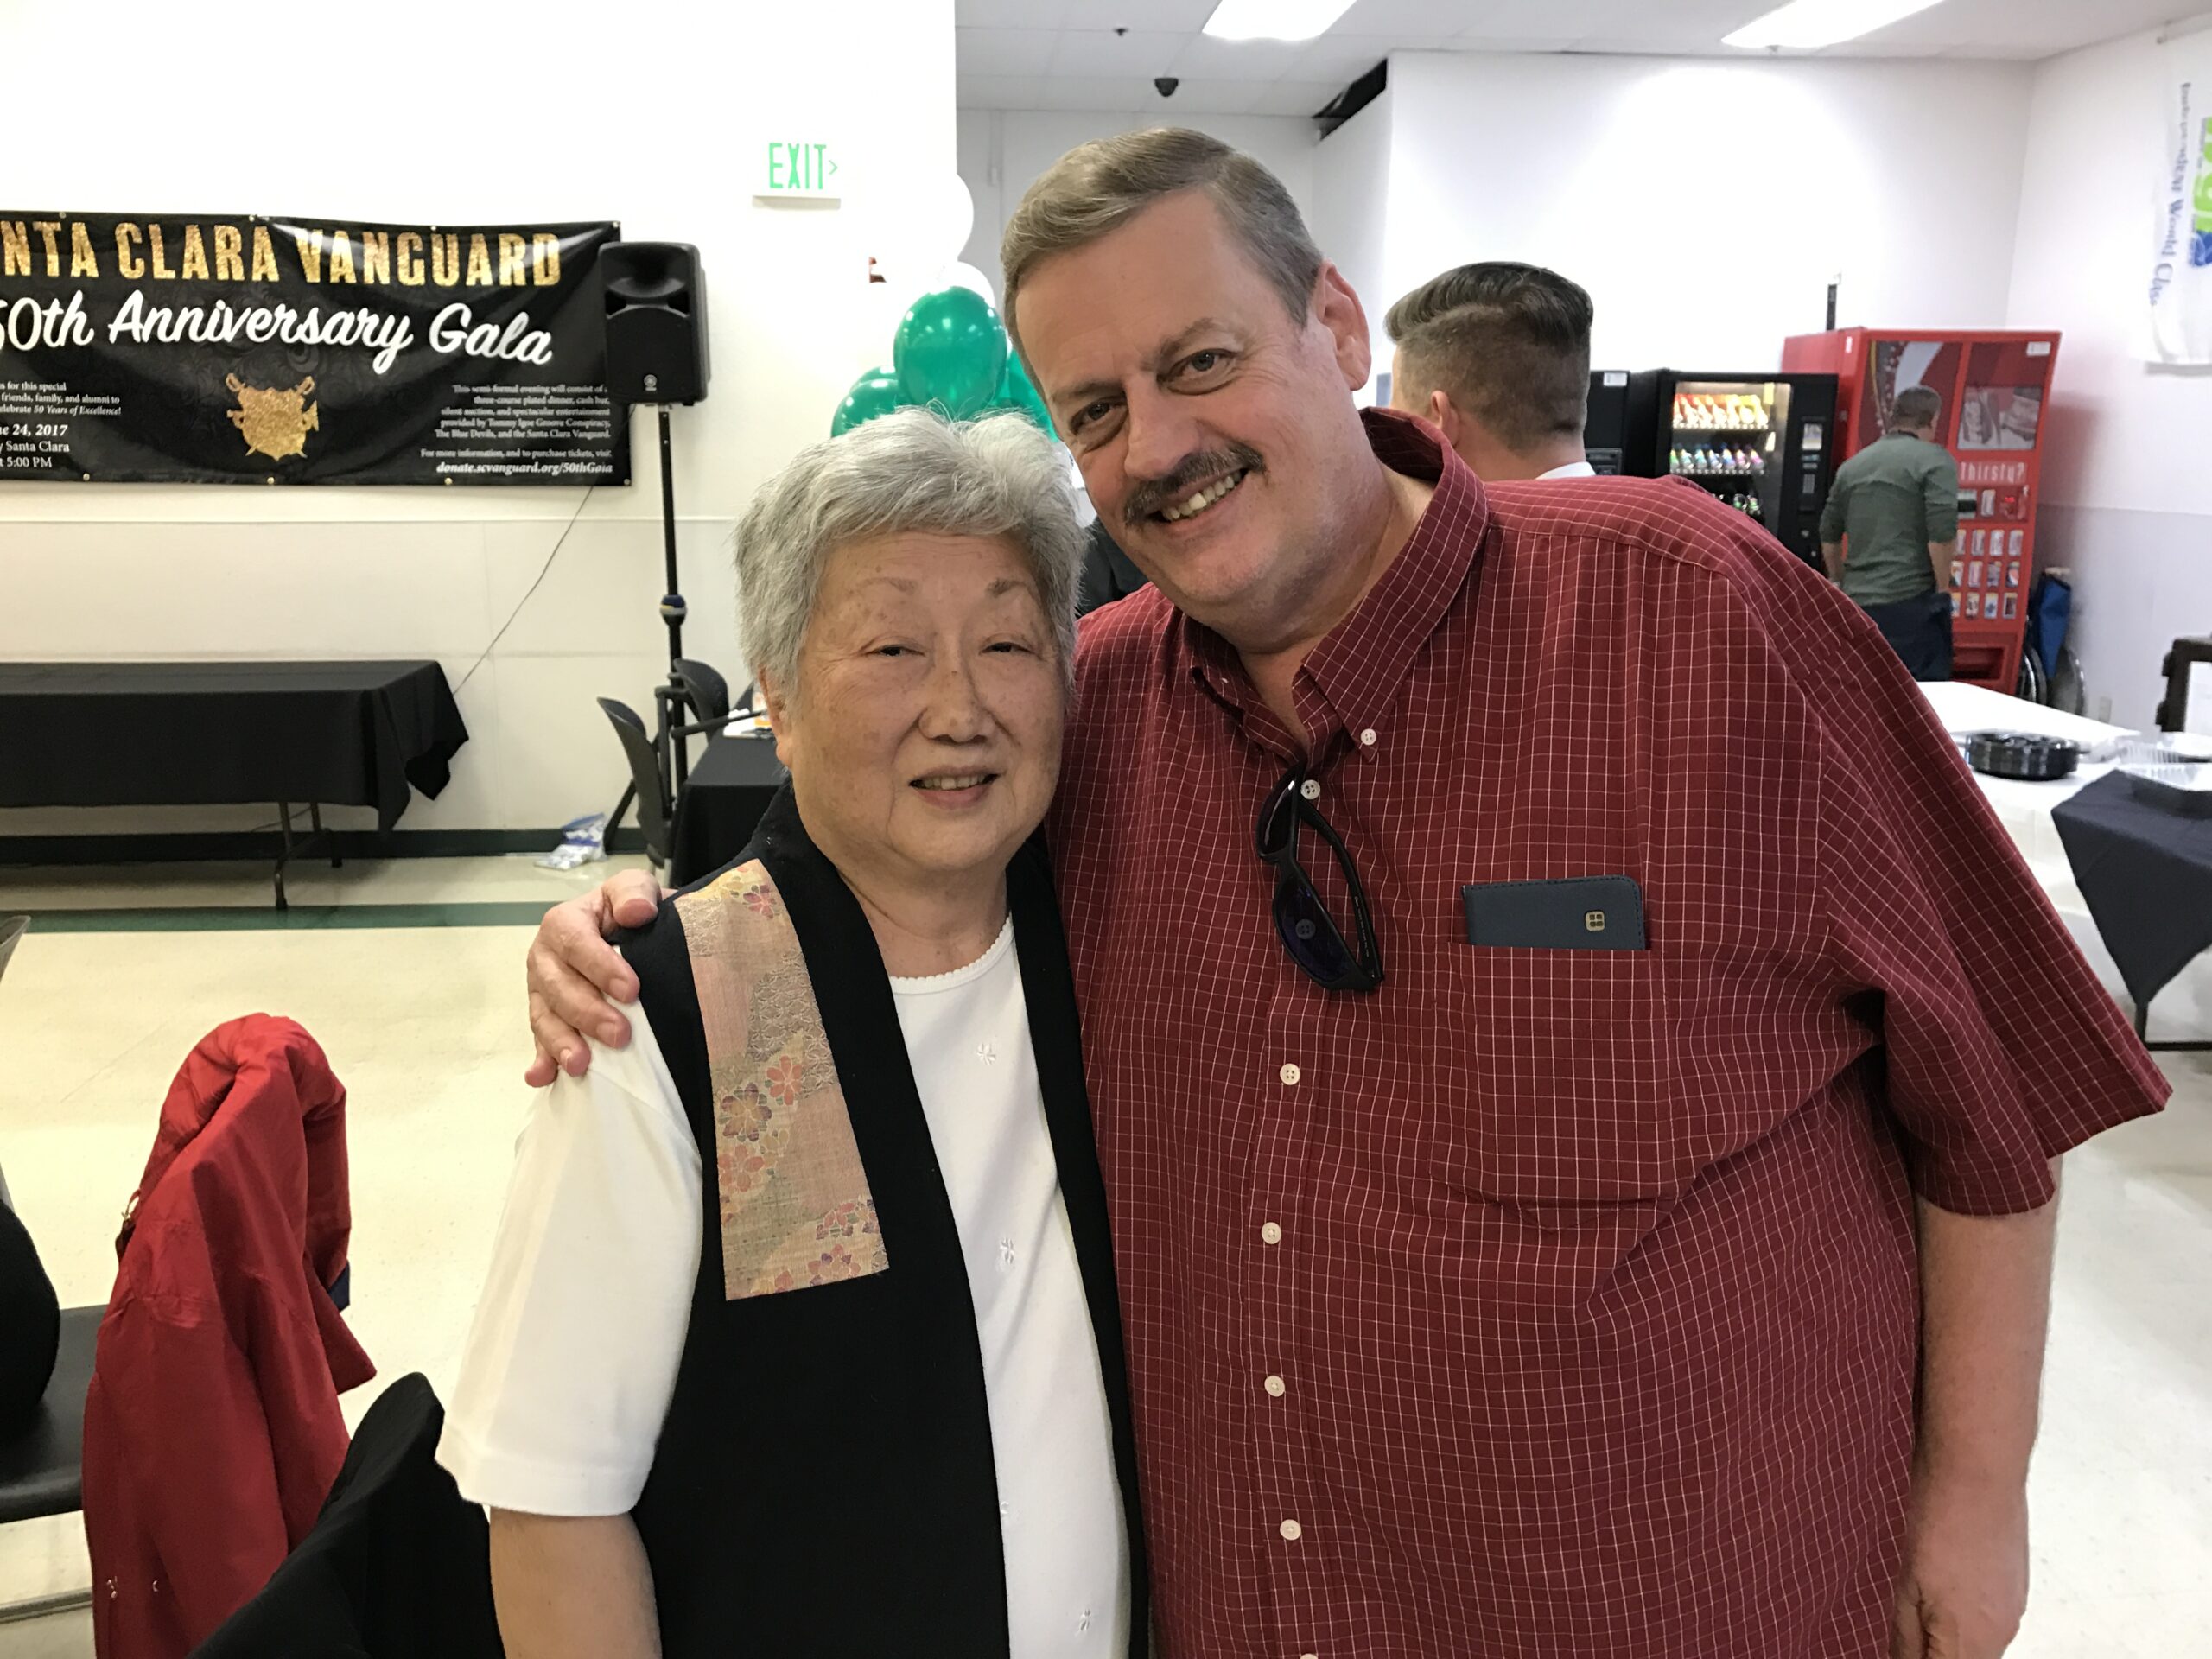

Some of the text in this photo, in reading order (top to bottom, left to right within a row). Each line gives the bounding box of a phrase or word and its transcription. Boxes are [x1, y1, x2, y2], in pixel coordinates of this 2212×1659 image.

[768, 142, 827, 190] EXIT
[2161, 198, 2185, 257] World
[114, 222, 280, 283] CLARA
[294, 227, 562, 287] VANGUARD
[108, 289, 414, 375] Anniversary
[429, 302, 554, 365] Gala
[7, 380, 20, 391] for
[39, 381, 67, 393] special
[1, 391, 34, 404] friends,
[111, 395, 121, 404] to
[33, 404, 45, 415] 50
[47, 405, 68, 415] Years
[69, 405, 79, 416] of
[12, 423, 31, 437] 24,
[35, 423, 69, 436] 2017
[5, 440, 36, 452] Santa
[38, 441, 70, 452] Clara
[6, 456, 30, 467] 5:00
[32, 456, 53, 468] PM
[1960, 461, 2026, 484] Thirsty?
